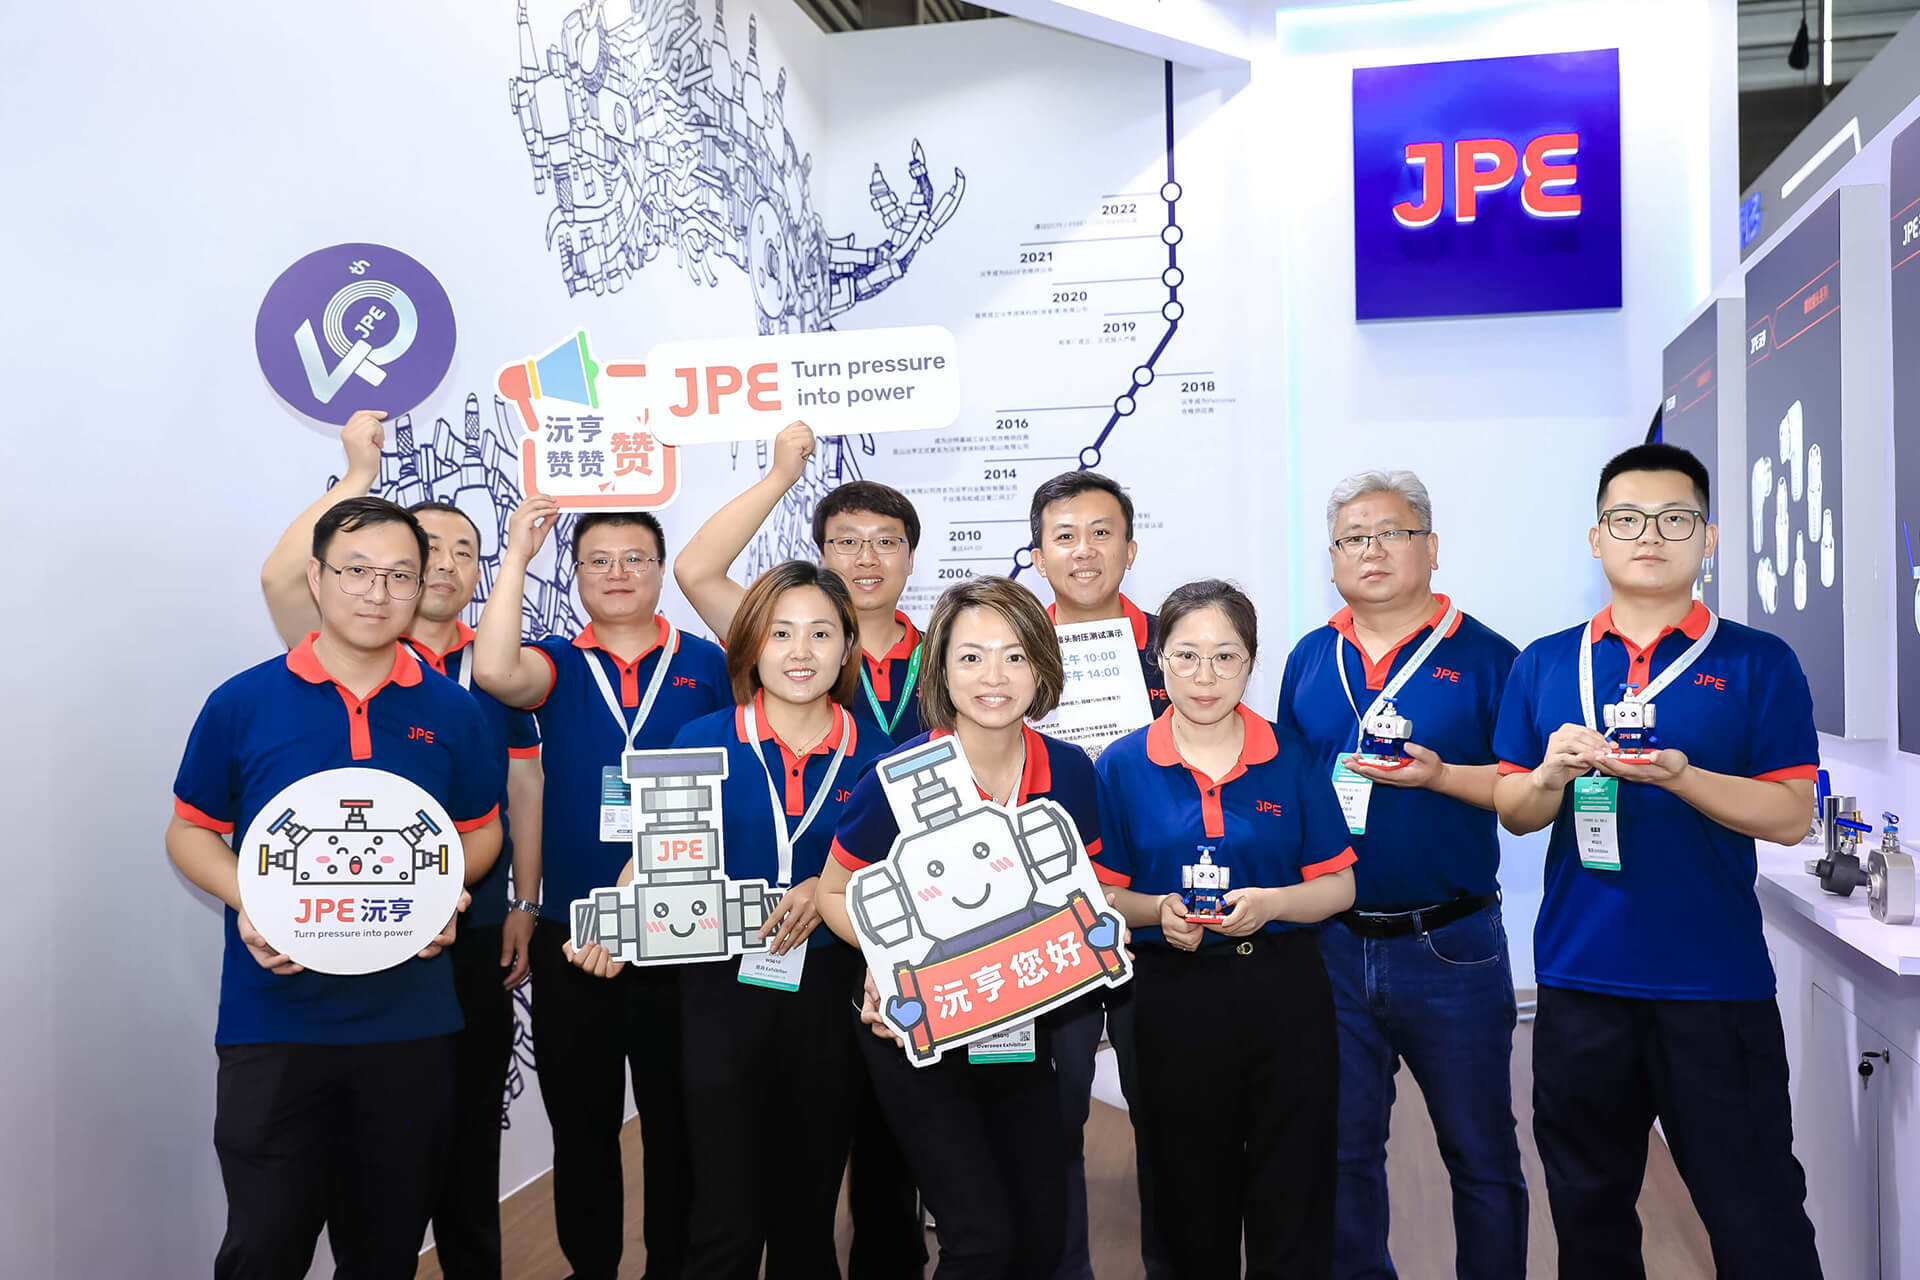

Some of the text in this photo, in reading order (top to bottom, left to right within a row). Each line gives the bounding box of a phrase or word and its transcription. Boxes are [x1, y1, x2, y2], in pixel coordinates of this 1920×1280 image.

[1392, 132, 1582, 227] JPE
[1101, 203, 1137, 216] 2022
[1020, 251, 1053, 264] 2021
[1052, 291, 1088, 303] 2020
[354, 305, 386, 339] JPE
[1103, 321, 1136, 334] 2019
[668, 353, 946, 418] JPE Turn pressure
[1181, 380, 1216, 393] 2018
[797, 384, 916, 408] into power
[545, 414, 605, 444] 沅亨
[996, 418, 1029, 430] 2016
[546, 431, 655, 478] 赞赞 赞
[984, 468, 1017, 480] 2014
[949, 530, 982, 541] 2010
[938, 568, 973, 579] 2006
[1084, 650, 1117, 663] 10:00
[1087, 666, 1120, 679] 14:00
[1432, 666, 1461, 683] JPE
[672, 676, 697, 689] JPE
[1693, 673, 1727, 691] JPE
[1149, 688, 1168, 700] PE
[408, 726, 435, 744] JPE
[1255, 800, 1282, 816] JPE
[657, 839, 704, 862] JPE
[294, 898, 414, 923] JPE 沅亨
[294, 929, 413, 939] Turn pressure into power
[932, 930, 1082, 1019] 沅亨您好
